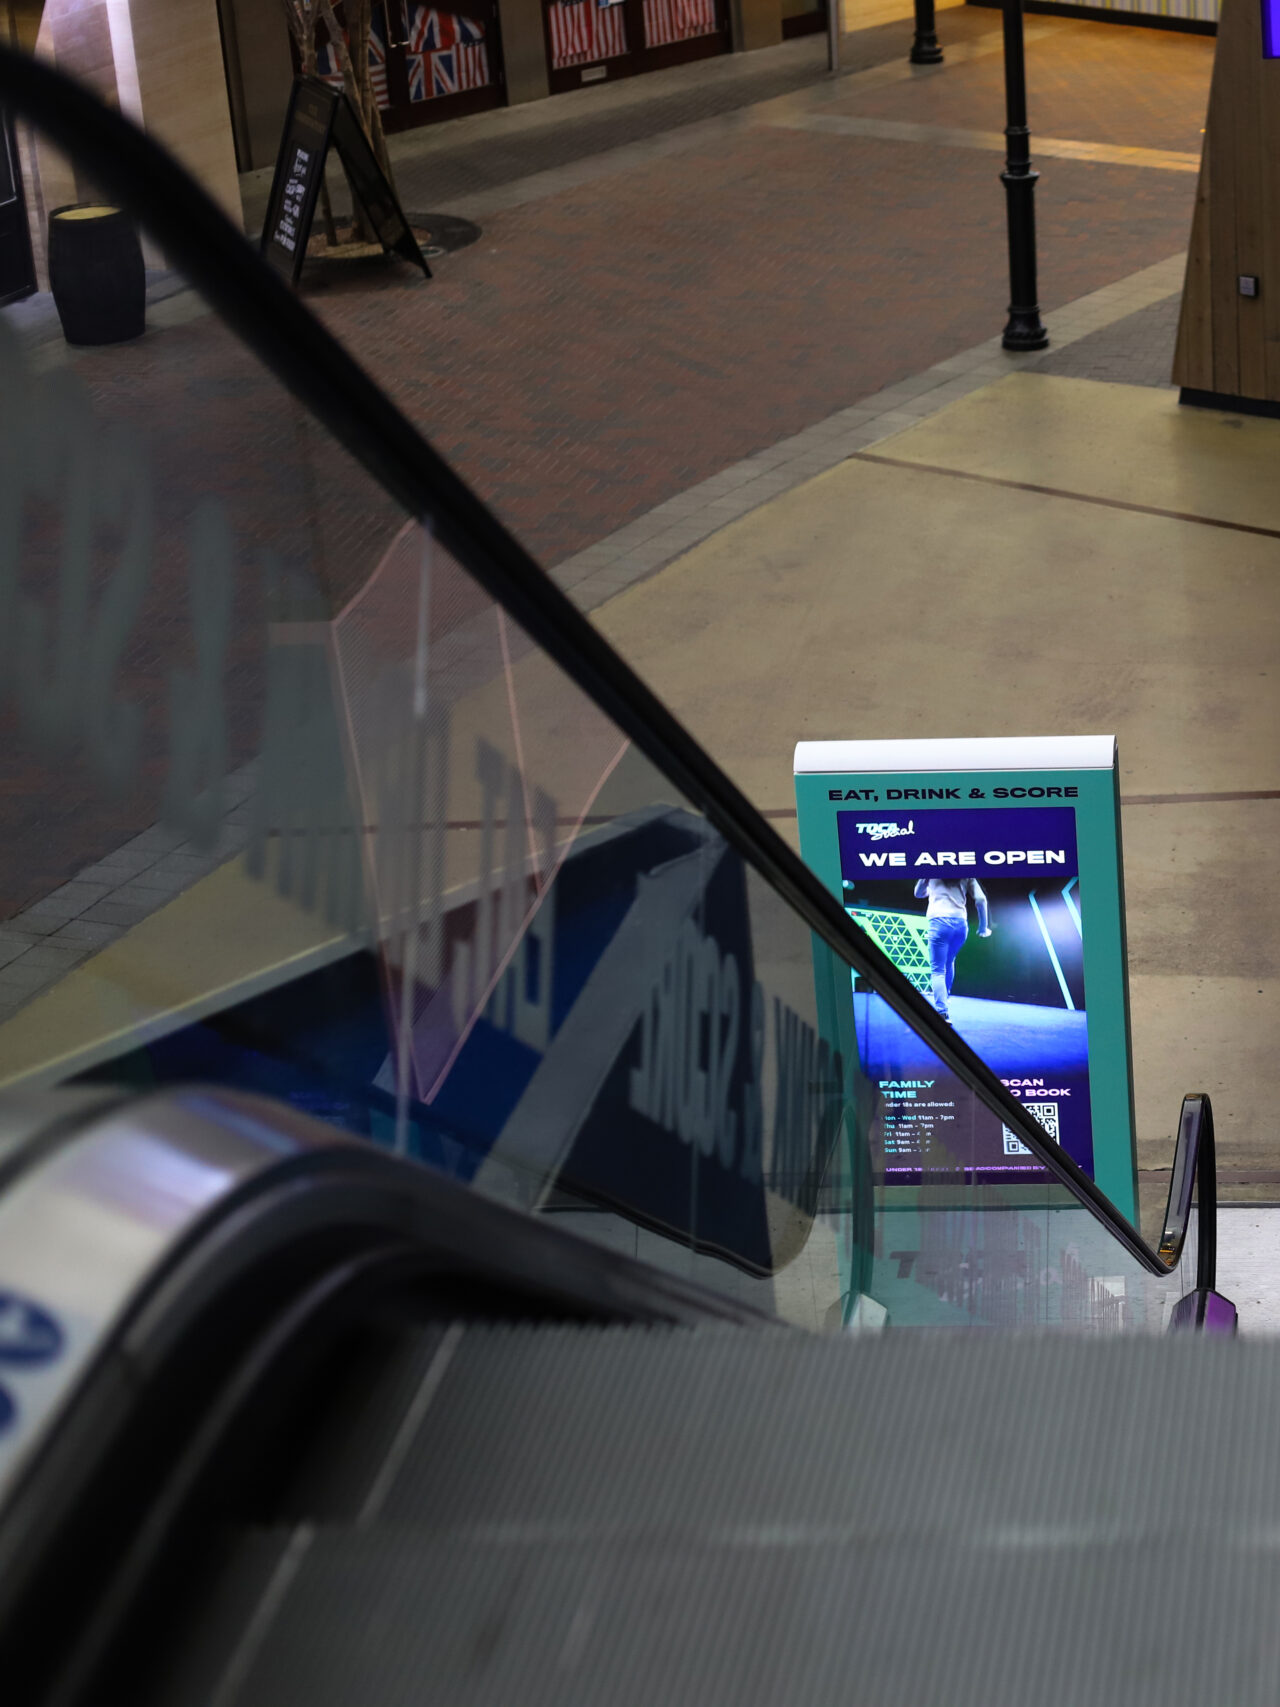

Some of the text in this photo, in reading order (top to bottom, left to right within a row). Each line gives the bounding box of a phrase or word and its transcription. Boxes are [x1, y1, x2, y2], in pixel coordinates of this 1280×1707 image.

[828, 786, 1079, 802] EAT, DRINK & SCORE
[858, 850, 1066, 867] WE ARE OPEN
[879, 1080, 935, 1088] FAMILY
[999, 1078, 1044, 1087] SCAN
[881, 1091, 917, 1099] TIME
[1010, 1088, 1071, 1097] O BOOK
[940, 1114, 954, 1122] 7pm
